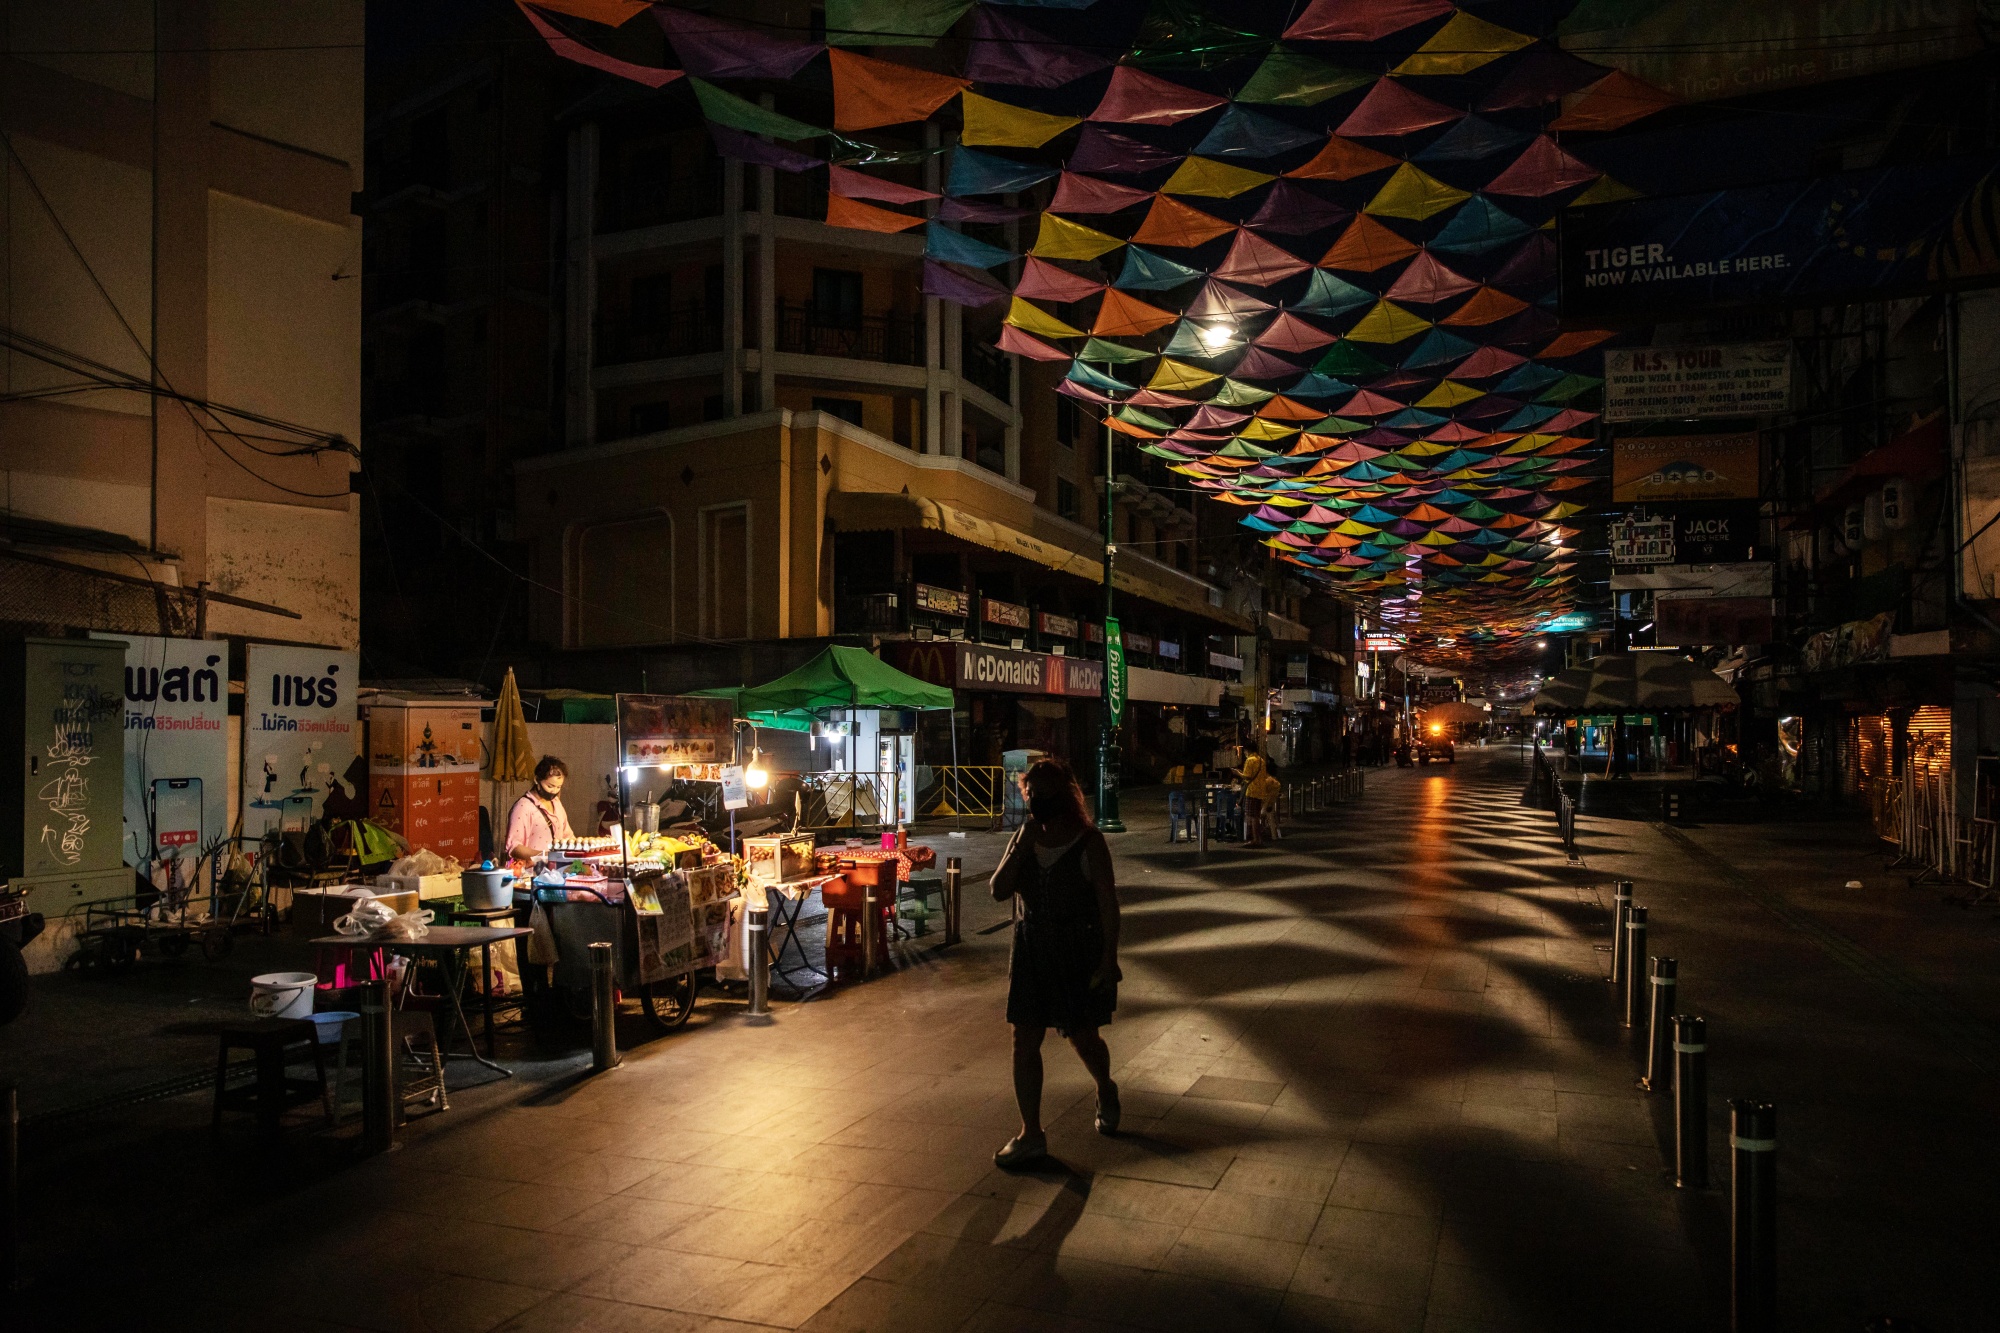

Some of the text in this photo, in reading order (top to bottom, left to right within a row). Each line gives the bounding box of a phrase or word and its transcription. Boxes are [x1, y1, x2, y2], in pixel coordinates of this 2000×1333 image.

[1732, 61, 1817, 86] Cuisine
[1585, 243, 1673, 270] TIGER.
[1585, 253, 1791, 288] NOW AVAILABLE HERE.
[1633, 350, 1722, 372] N.S. TOUR
[1613, 375, 1645, 384] WORLD
[1648, 374, 1671, 382] WIDE
[1686, 370, 1731, 381] DOMESTIC
[1734, 369, 1750, 378] AIR
[1752, 367, 1783, 376] TICKET
[1609, 390, 1784, 407] SIGHT SEEING TOUR HOTEL BOOKING
[1625, 380, 1770, 395] JOIN TICKET TRAIN BUS BOAT
[1685, 520, 1729, 535] JACK
[1685, 533, 1730, 543] LIVES HERE
[964, 651, 1040, 686] McDonald's
[272, 665, 339, 708] แชร์
[1110, 649, 1120, 714] Chang
[1422, 690, 1457, 698] TATTOO
